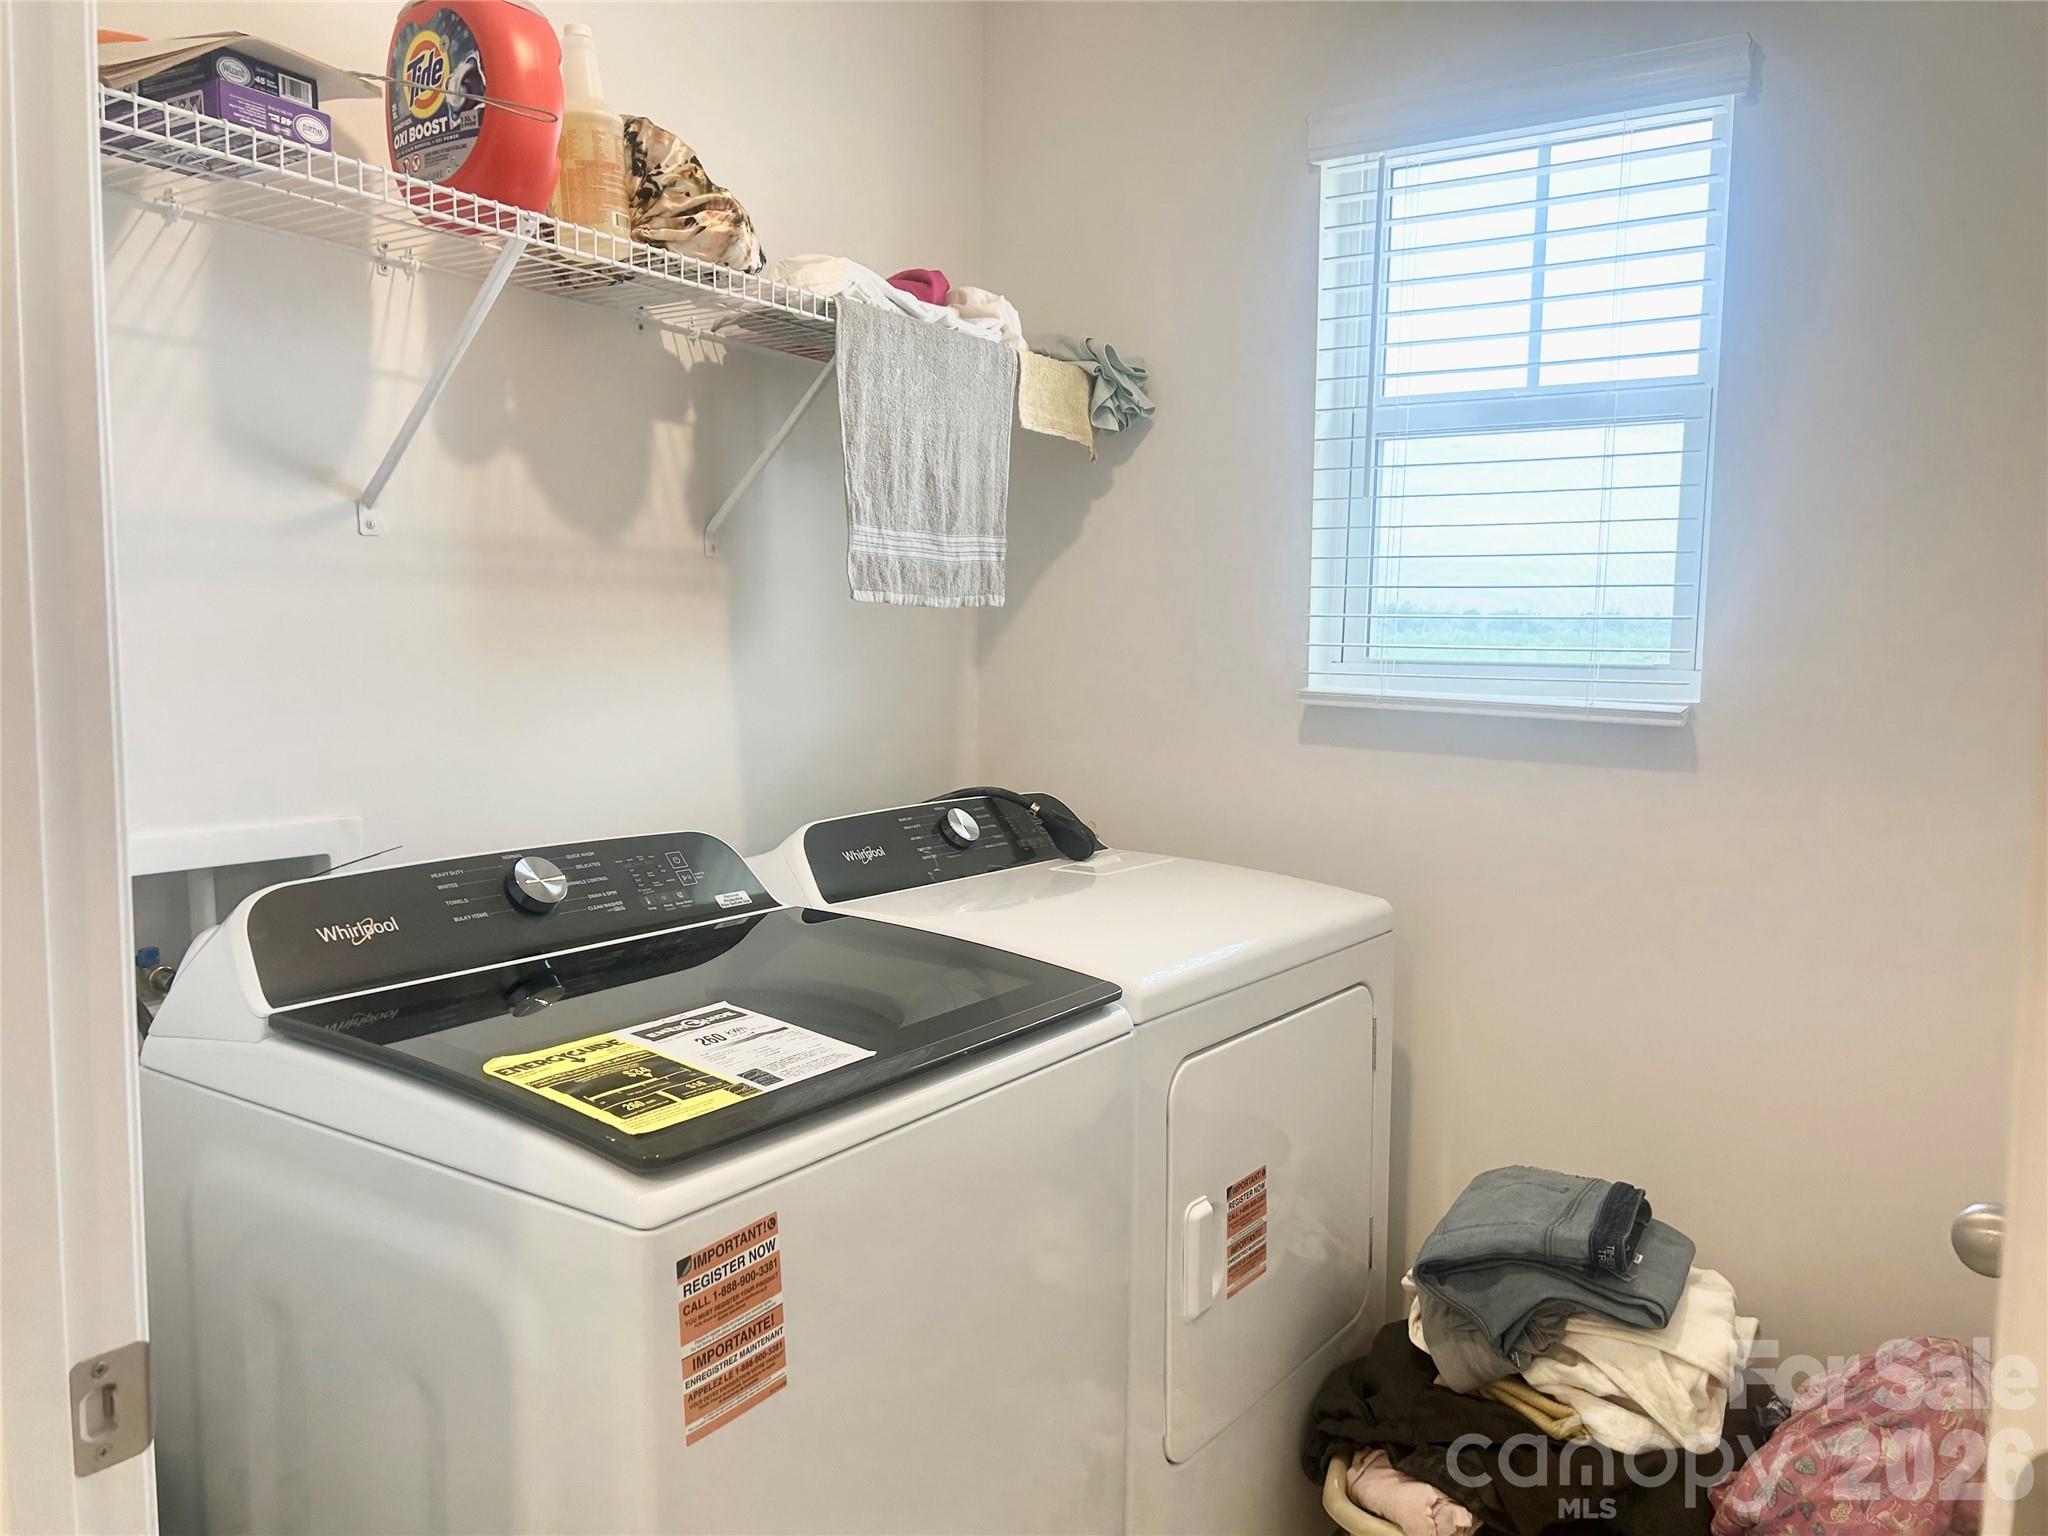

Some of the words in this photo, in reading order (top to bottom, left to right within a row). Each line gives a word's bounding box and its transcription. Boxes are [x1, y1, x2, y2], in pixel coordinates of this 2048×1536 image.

[407, 50, 444, 110] Tide
[394, 131, 408, 150] OXI
[409, 116, 448, 141] BOOST
[841, 846, 886, 864] Whirlpool
[445, 898, 469, 906] TOWELS
[315, 916, 400, 947] Whirlpool
[695, 1033, 727, 1046] 260
[1228, 1189, 1254, 1210] REGISTER
[693, 1220, 767, 1270] IMPORTANT!
[683, 1255, 746, 1298] REGISTER
[748, 1238, 776, 1263] NOW
[683, 1295, 711, 1316] CALL
[713, 1258, 778, 1300] 1-888-900-3381
[685, 1354, 739, 1389] ENREGISTREZ
[740, 1326, 784, 1359] MAINTENANT
[692, 1314, 774, 1371] IMPORTANTE!
[688, 1377, 722, 1403] APPELEZ
[724, 1368, 734, 1380] LE
